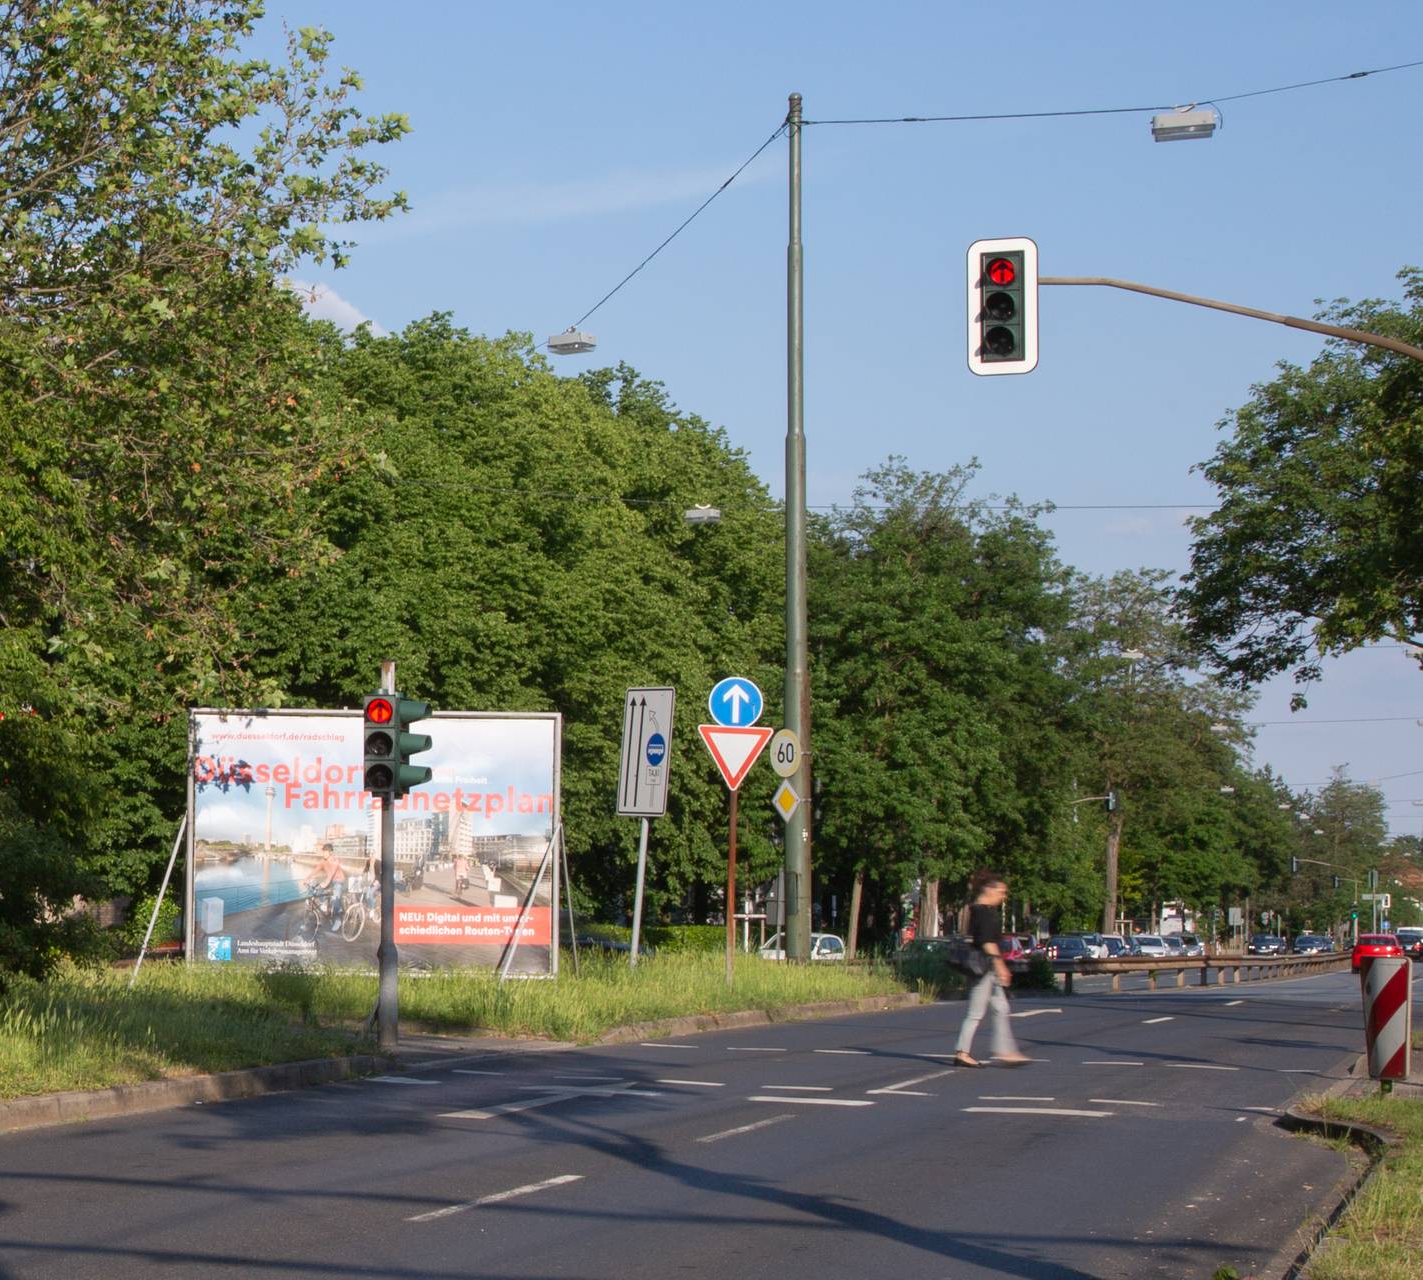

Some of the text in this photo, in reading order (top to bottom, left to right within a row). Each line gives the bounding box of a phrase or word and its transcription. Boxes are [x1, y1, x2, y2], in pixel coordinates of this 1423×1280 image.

[778, 743, 794, 764] 60
[399, 912, 424, 922] NEU:
[427, 912, 460, 924] Digital
[462, 913, 481, 923] und
[484, 913, 500, 923] mit
[399, 925, 462, 935] schiedlichen
